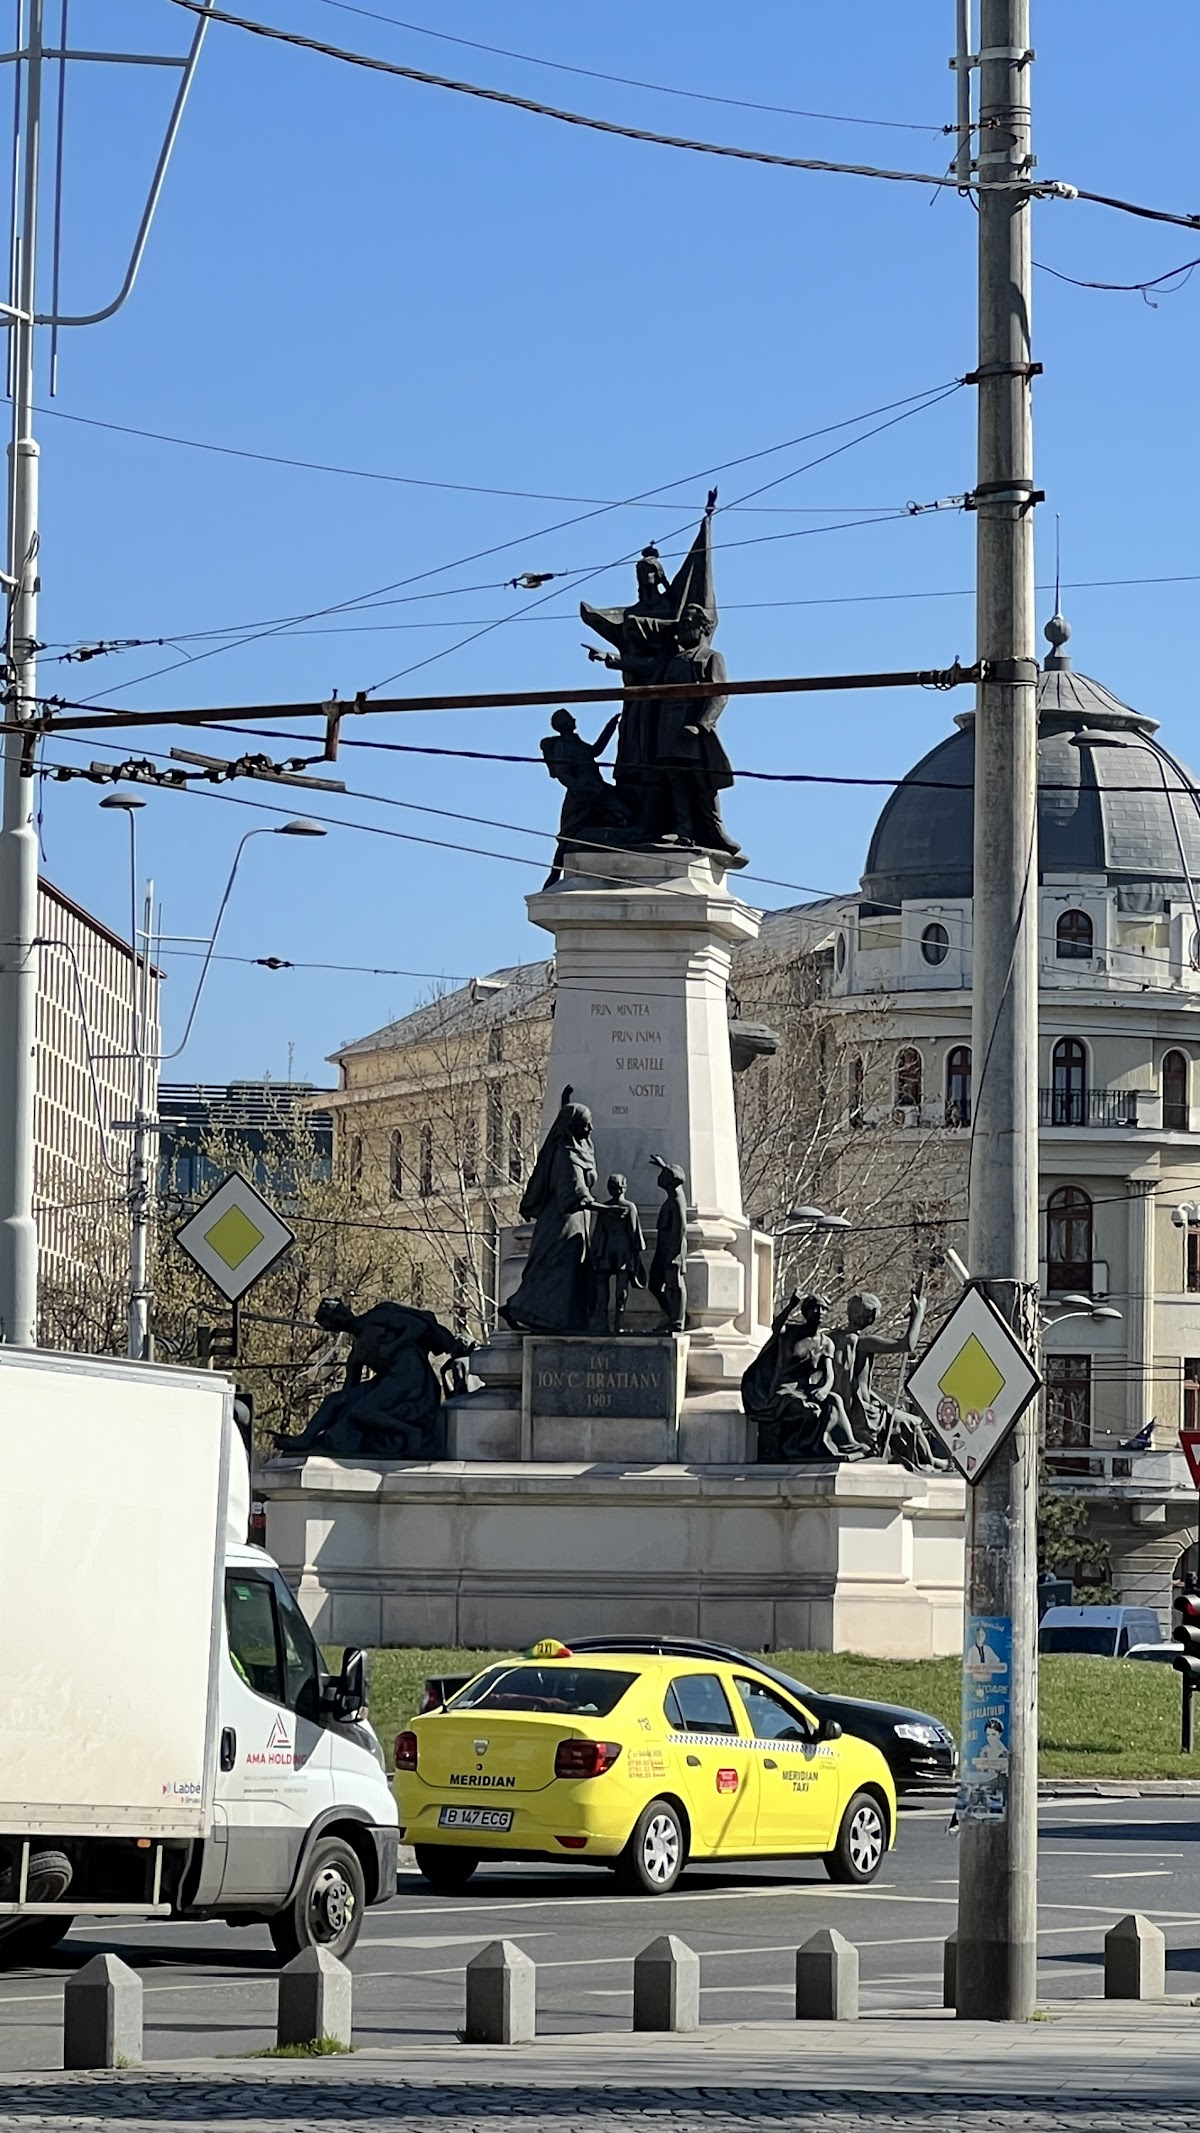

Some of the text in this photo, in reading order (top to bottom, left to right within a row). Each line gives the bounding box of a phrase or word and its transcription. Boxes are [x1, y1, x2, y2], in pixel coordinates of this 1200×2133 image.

[590, 1003, 650, 1017] PRIN MINTEA
[611, 1030, 662, 1043] PRIN INIMA
[590, 1356, 609, 1370] LVI
[587, 1393, 612, 1408] 1903
[245, 1753, 308, 1766] AMA HOLDING
[449, 1774, 516, 1788] MERIDIAN
[782, 1770, 819, 1782] MERIDIAN
[792, 1782, 810, 1792] TAXI
[447, 1810, 509, 1826] B 147 ECG
